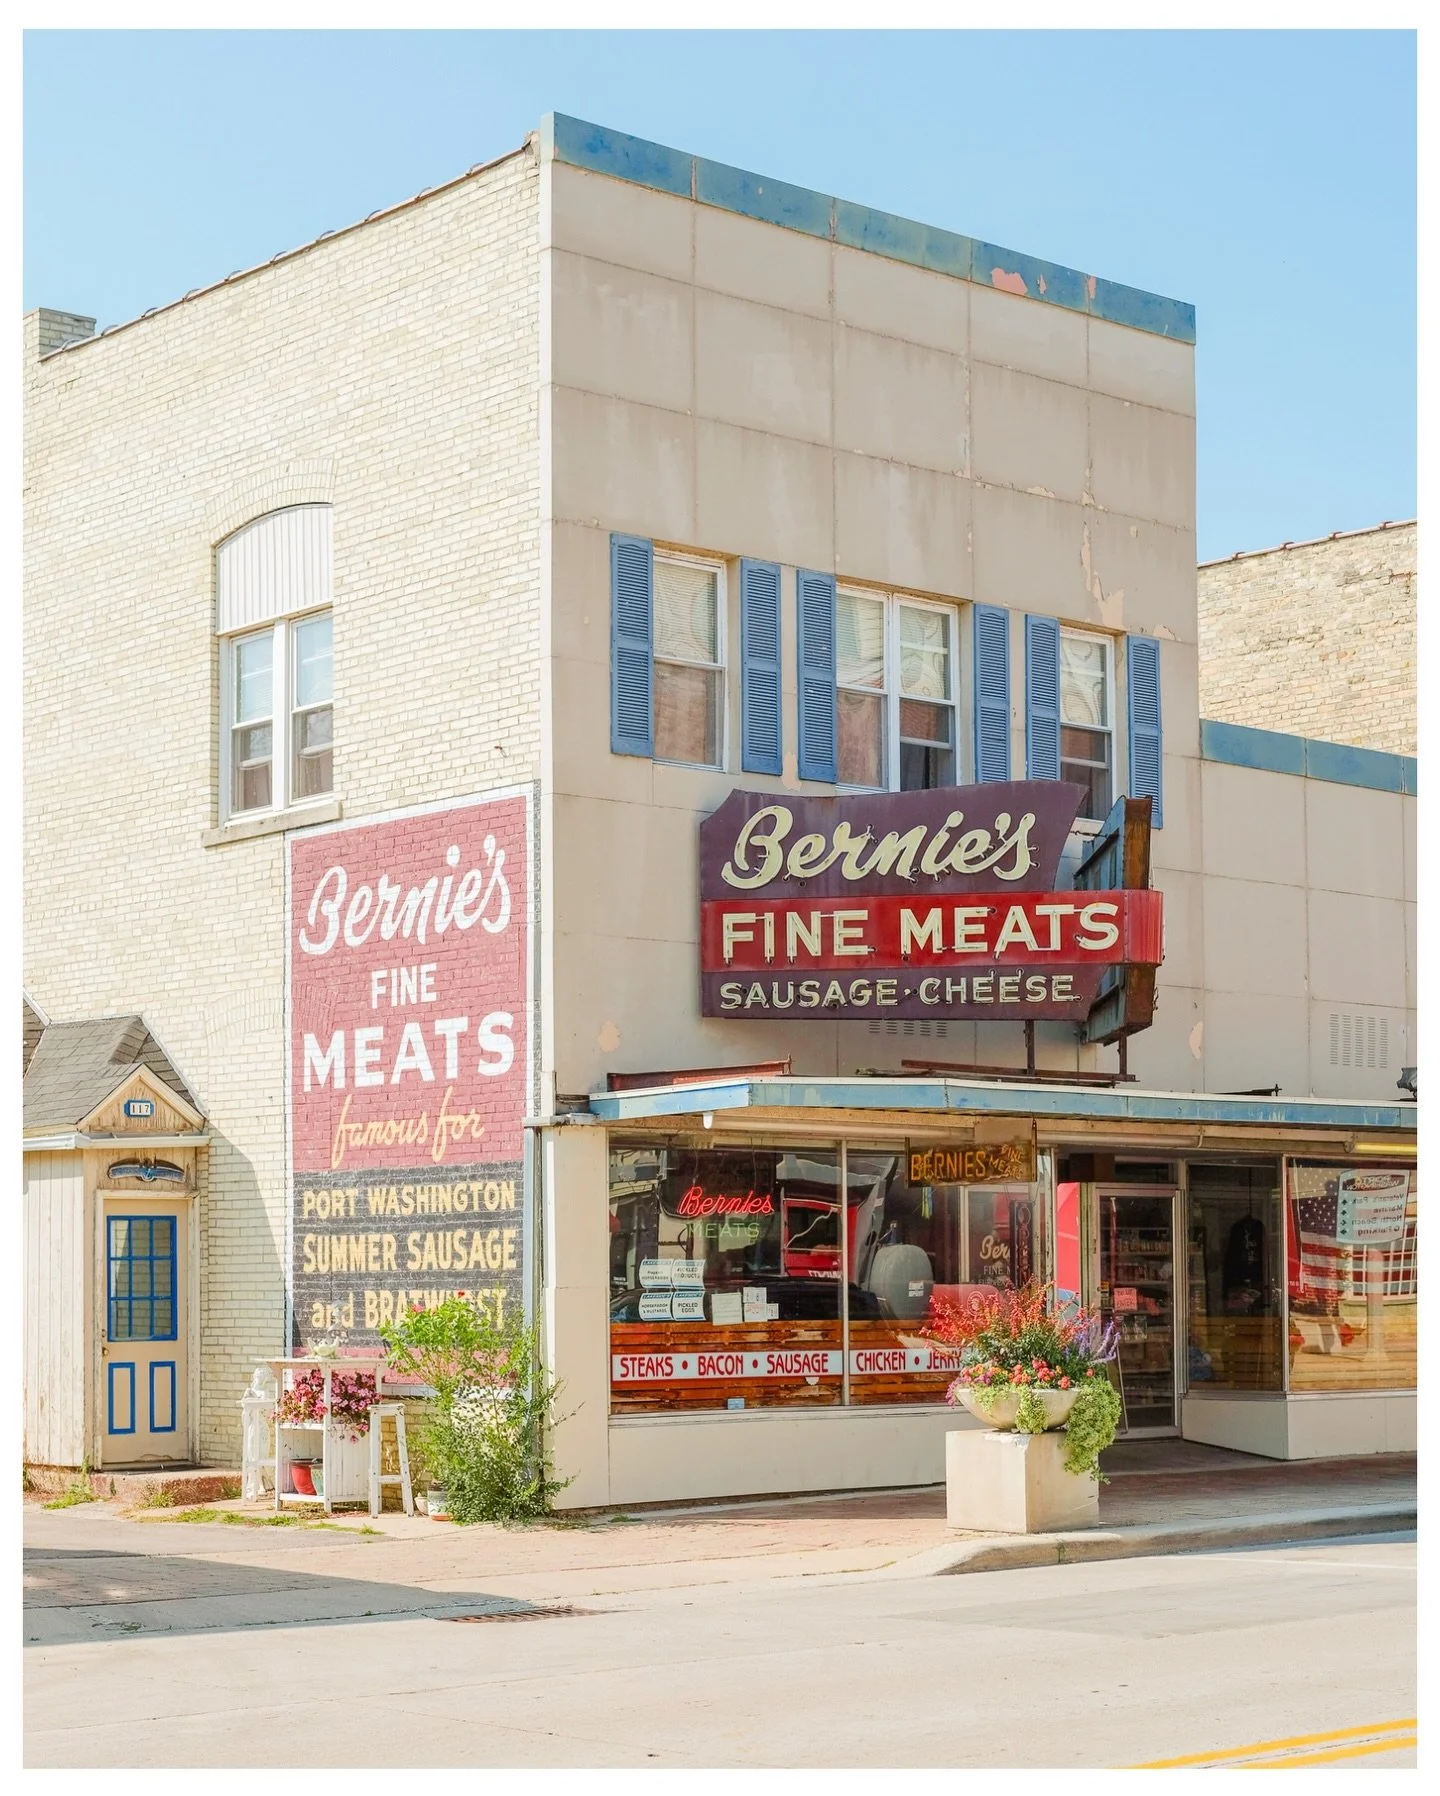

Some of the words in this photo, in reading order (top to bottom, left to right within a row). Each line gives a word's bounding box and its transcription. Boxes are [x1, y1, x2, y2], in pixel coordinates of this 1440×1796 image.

[721, 805, 1037, 890] Bernie's
[299, 834, 512, 955] Bernie's
[722, 908, 873, 960] FINE
[900, 901, 1119, 956] MEATS
[371, 963, 437, 1009] FINE
[719, 977, 898, 1010] SAUSAGE
[918, 973, 1075, 1006] CHEESE
[303, 1011, 515, 1092] MEATS
[130, 1103, 150, 1114] 117
[331, 1093, 428, 1169] famous
[431, 1086, 485, 1162] for
[911, 1150, 986, 1181] BERNIES
[989, 1155, 1024, 1180] MEATS
[303, 1187, 358, 1219] PORT
[368, 1181, 515, 1216] WASHINGTON
[685, 1222, 760, 1239] MEATS
[980, 1235, 1011, 1260] Ber
[303, 1233, 398, 1274] SUMMER
[407, 1228, 517, 1271] SAUSAGE
[620, 1355, 674, 1378] STEAKS
[697, 1354, 744, 1376] BACON
[766, 1353, 829, 1374] SAUSAGE
[856, 1351, 906, 1372] CHICKEN
